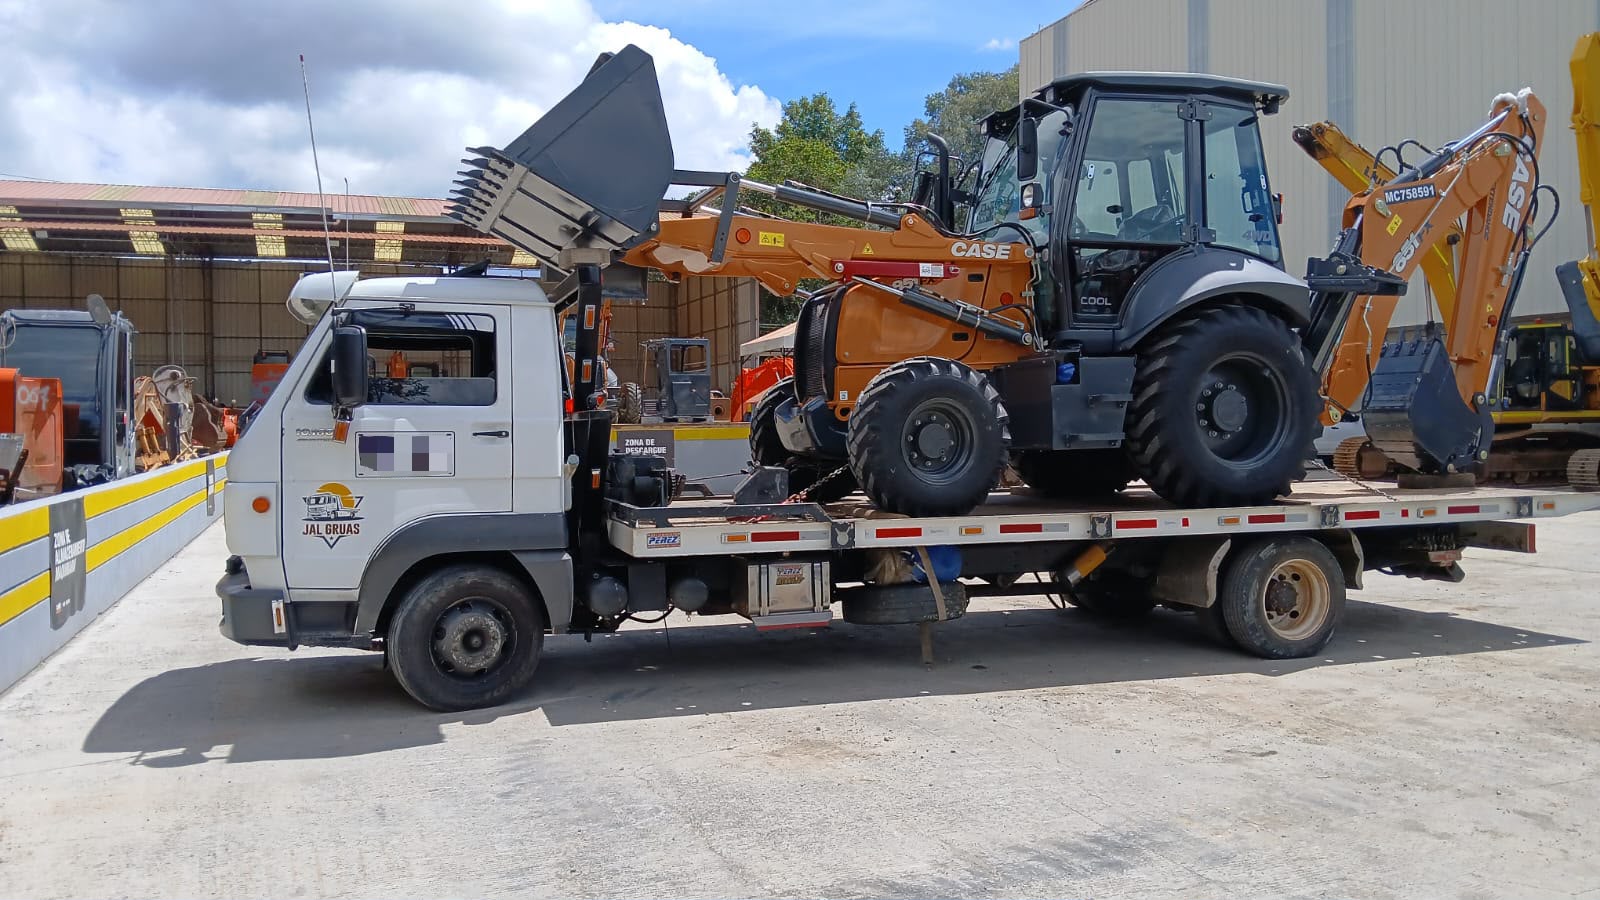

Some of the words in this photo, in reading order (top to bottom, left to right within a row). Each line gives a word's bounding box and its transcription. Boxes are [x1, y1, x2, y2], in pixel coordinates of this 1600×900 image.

[1502, 135, 1535, 235] CASE
[1385, 184, 1435, 203] MC758591
[951, 241, 1012, 260] CASE
[1080, 296, 1112, 306] COOL
[625, 438, 644, 446] ZONA
[645, 438, 656, 446] DE
[625, 446, 667, 455] DESCARGUE
[302, 523, 322, 535] JAL
[325, 523, 360, 535] GRUAS
